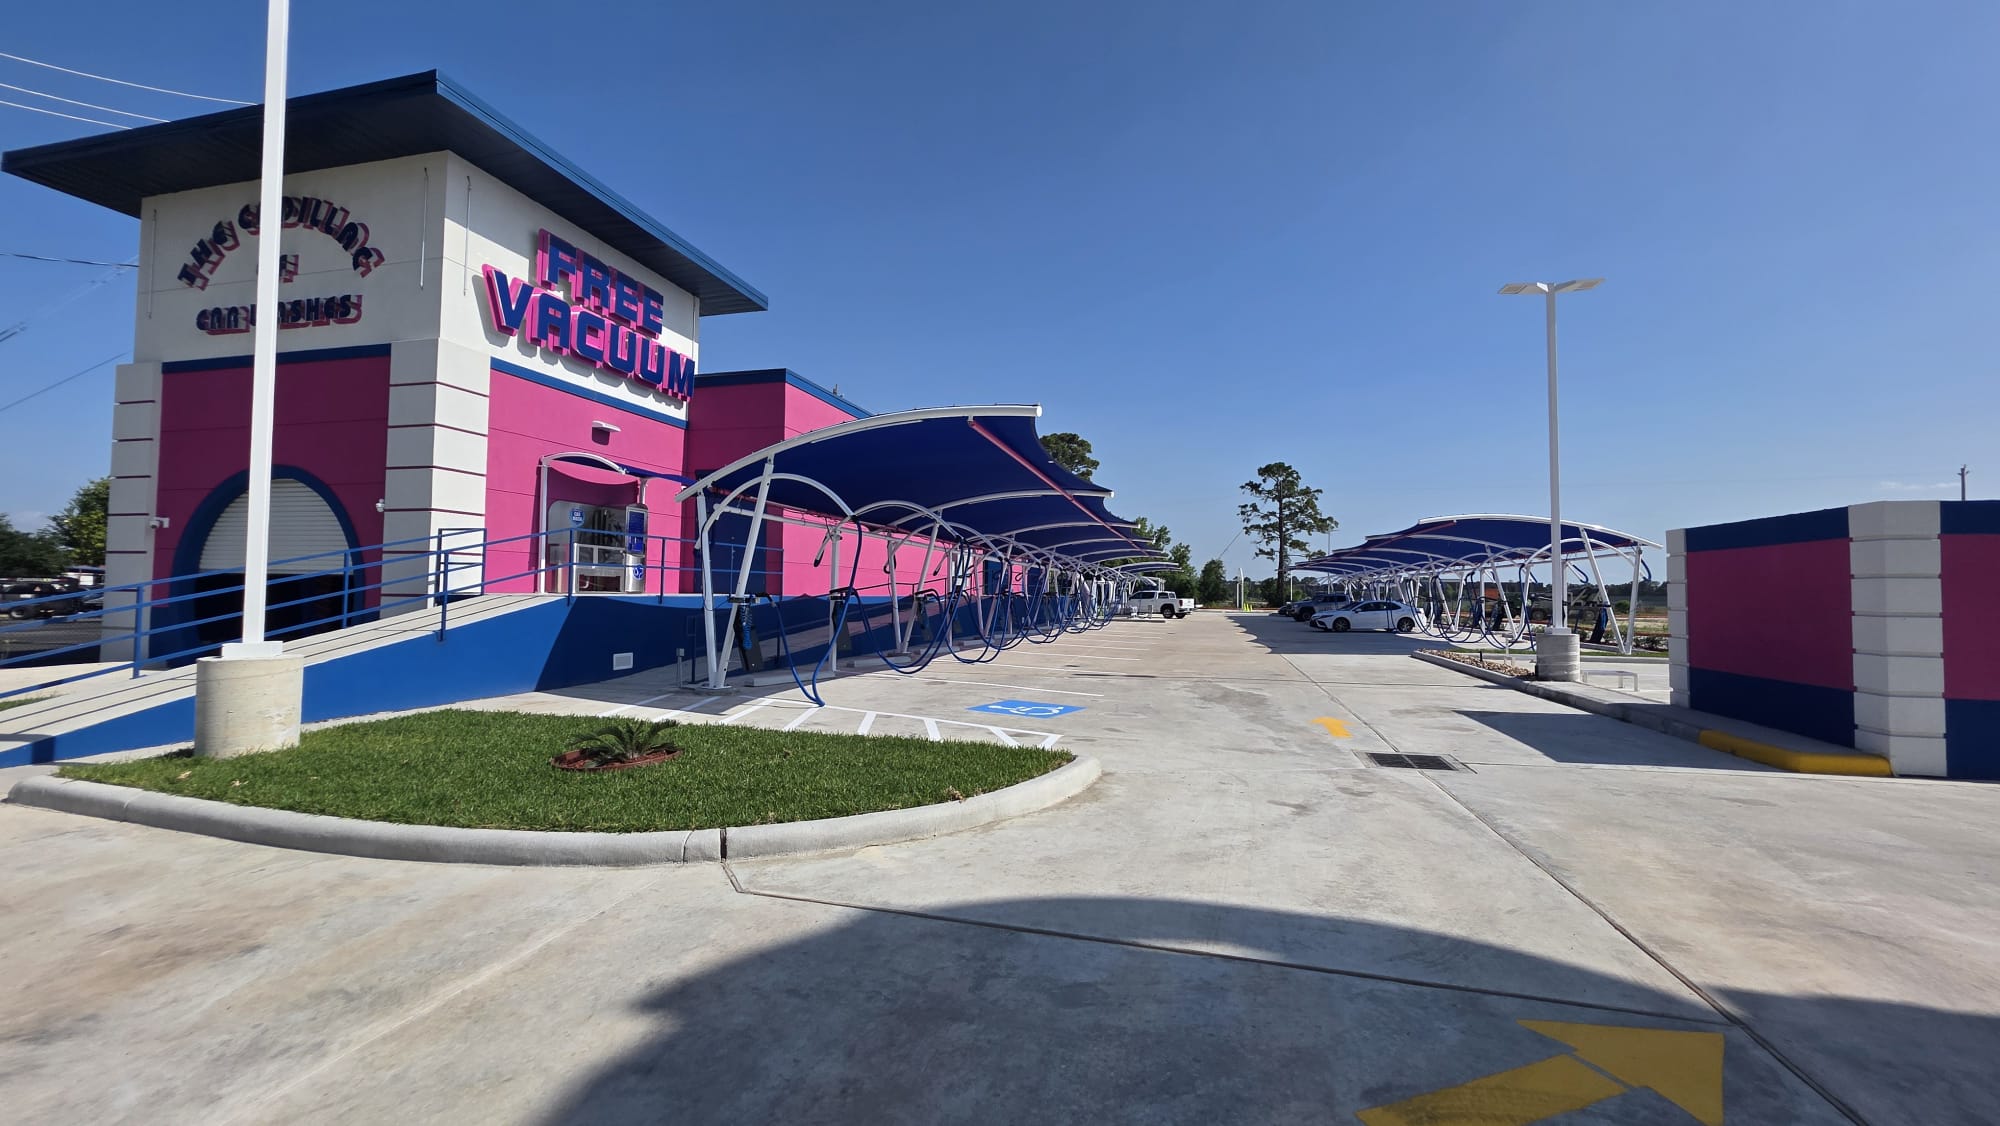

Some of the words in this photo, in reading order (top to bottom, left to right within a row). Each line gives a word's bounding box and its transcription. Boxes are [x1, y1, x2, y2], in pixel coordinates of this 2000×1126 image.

[238, 196, 385, 279] CDILLAC
[538, 228, 664, 338] FREE
[250, 294, 363, 331] ASHES
[482, 264, 695, 402] VACUUM
